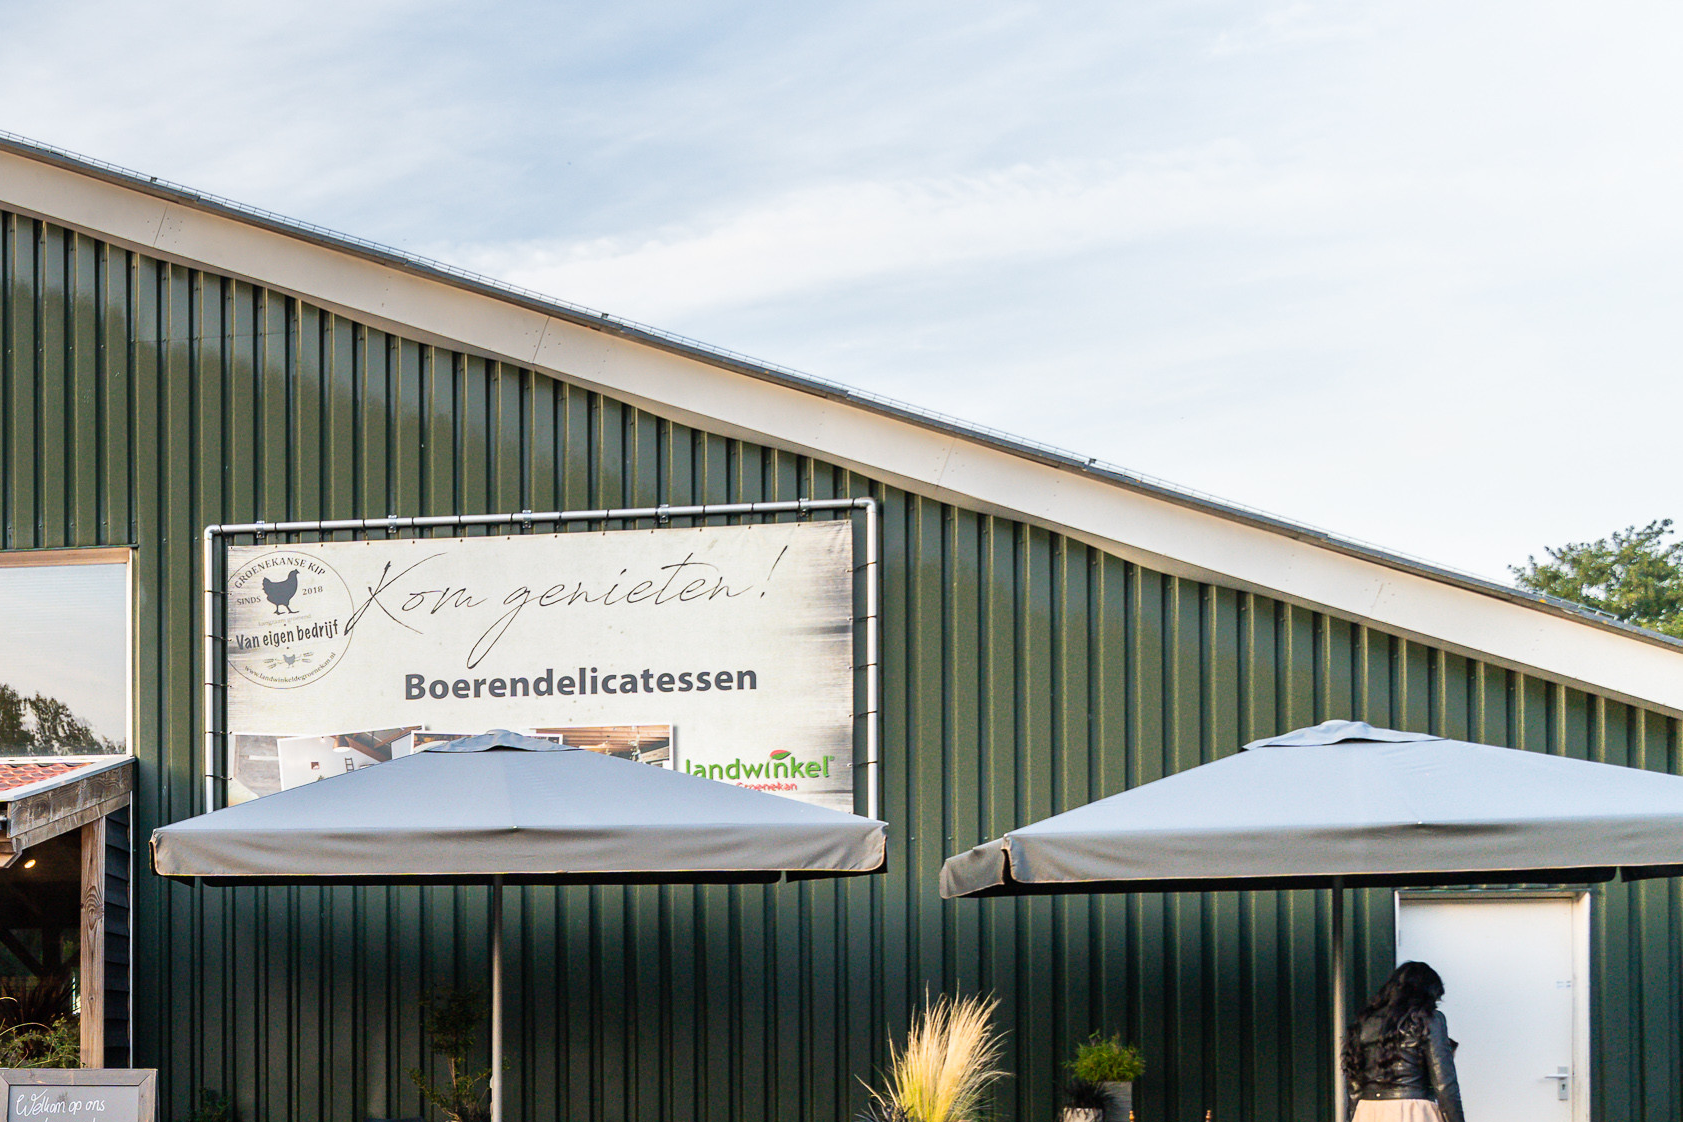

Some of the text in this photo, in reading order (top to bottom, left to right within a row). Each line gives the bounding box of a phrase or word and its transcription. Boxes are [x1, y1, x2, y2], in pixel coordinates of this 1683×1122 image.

[234, 557, 326, 589] GROENEKANSE KIP
[237, 596, 261, 606] SINDS
[302, 585, 323, 596] 2018
[344, 545, 789, 669] Kom genieten!
[236, 619, 339, 651] Van eigen bedrijf
[405, 667, 757, 701] Boerendelicatessen
[685, 754, 831, 781] landwinkel
[16, 1088, 106, 1117] Welkom op ons
